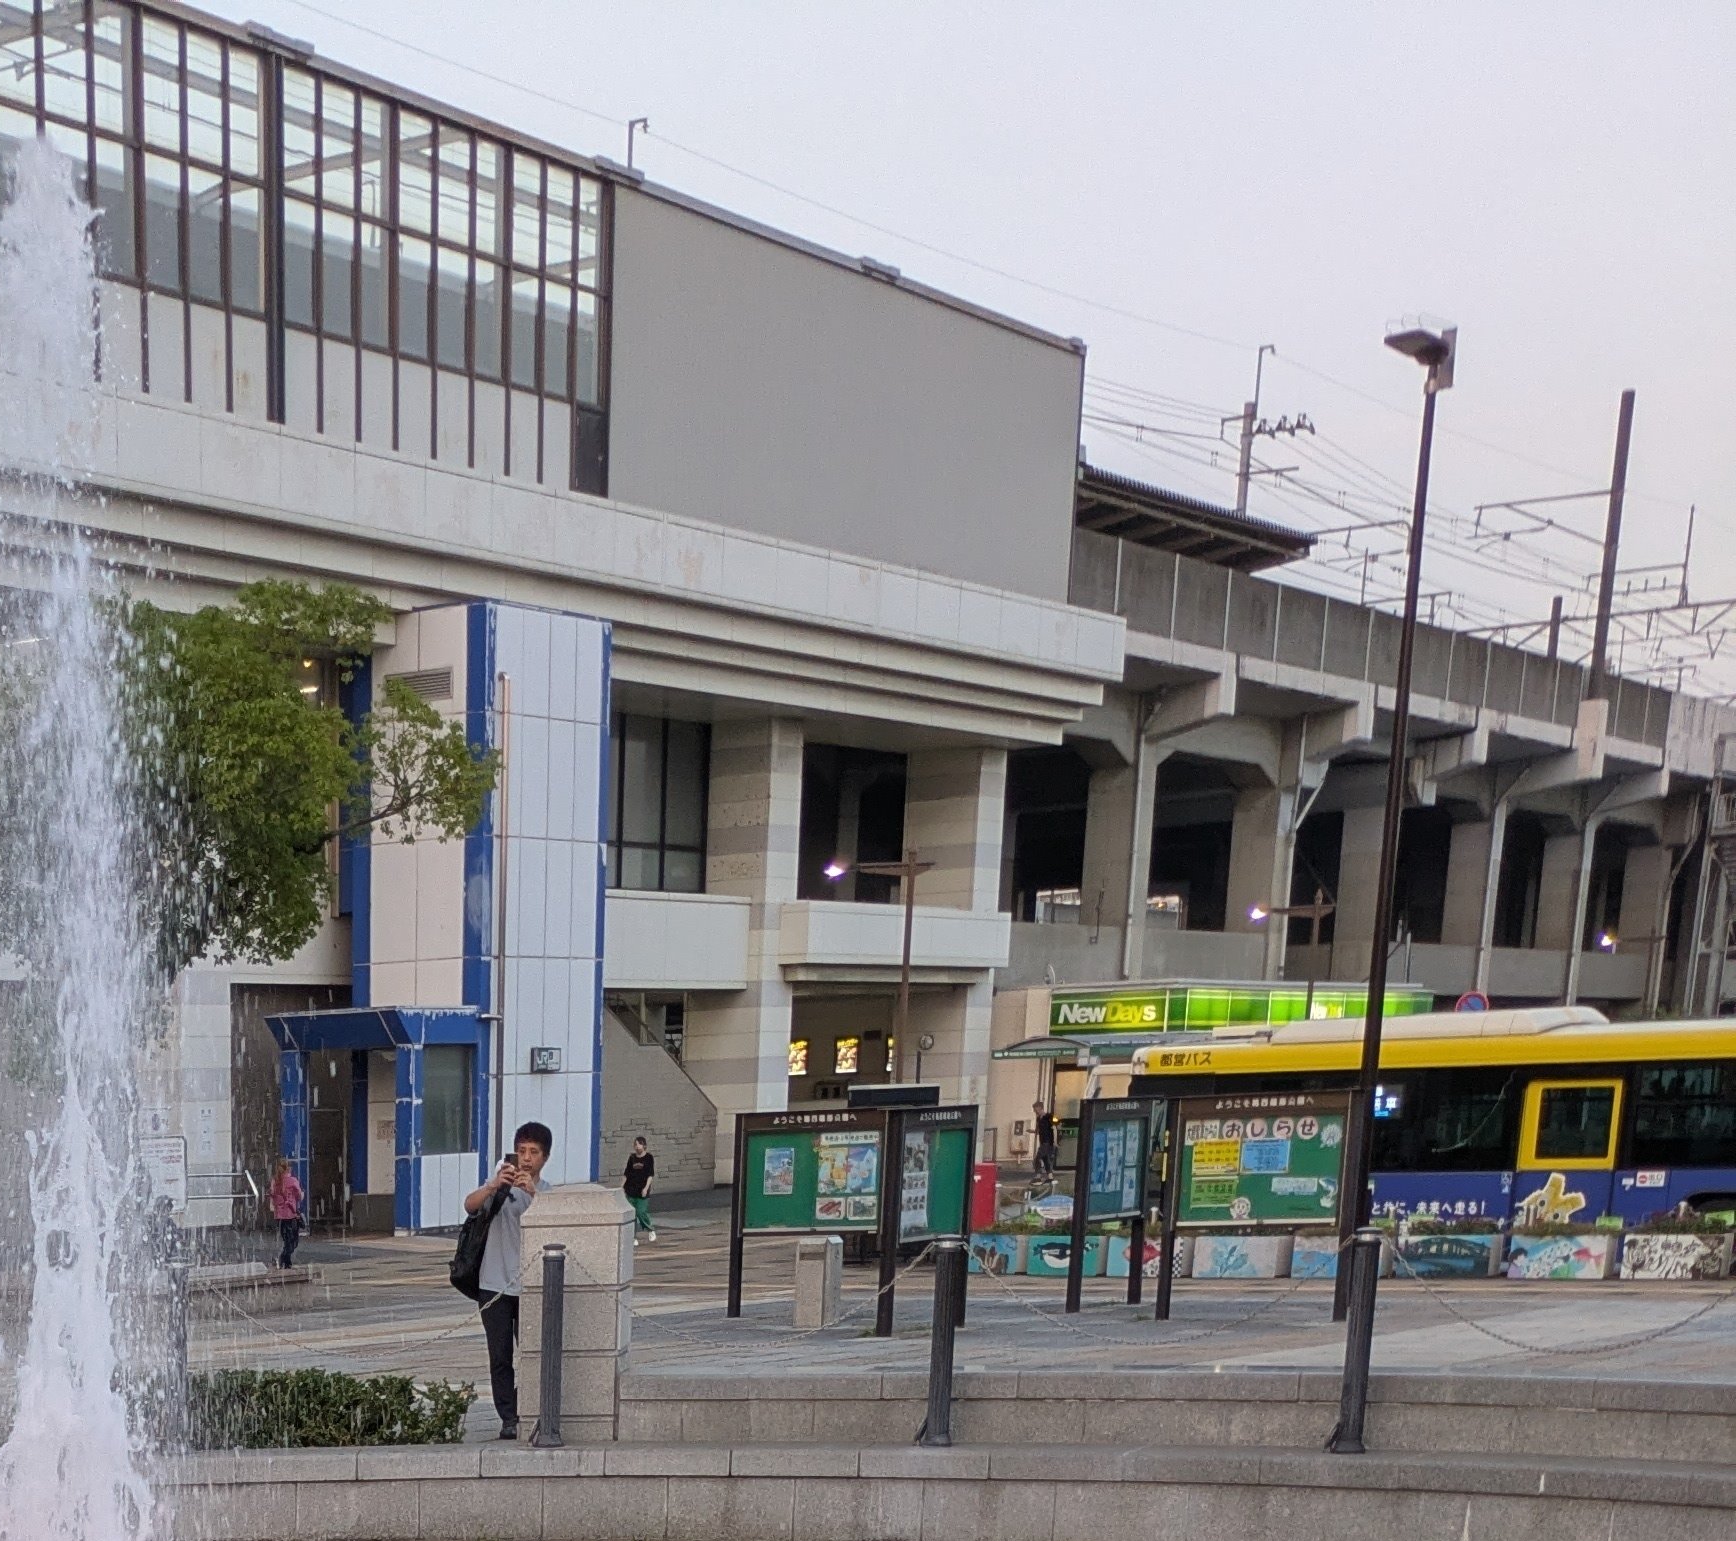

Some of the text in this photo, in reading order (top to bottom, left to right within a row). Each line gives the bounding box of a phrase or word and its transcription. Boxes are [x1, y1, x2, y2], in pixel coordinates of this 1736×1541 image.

[1058, 1002, 1157, 1024] NewDays
[1160, 1051, 1212, 1067] 都営バス
[1225, 1119, 1316, 1139] おしらせ
